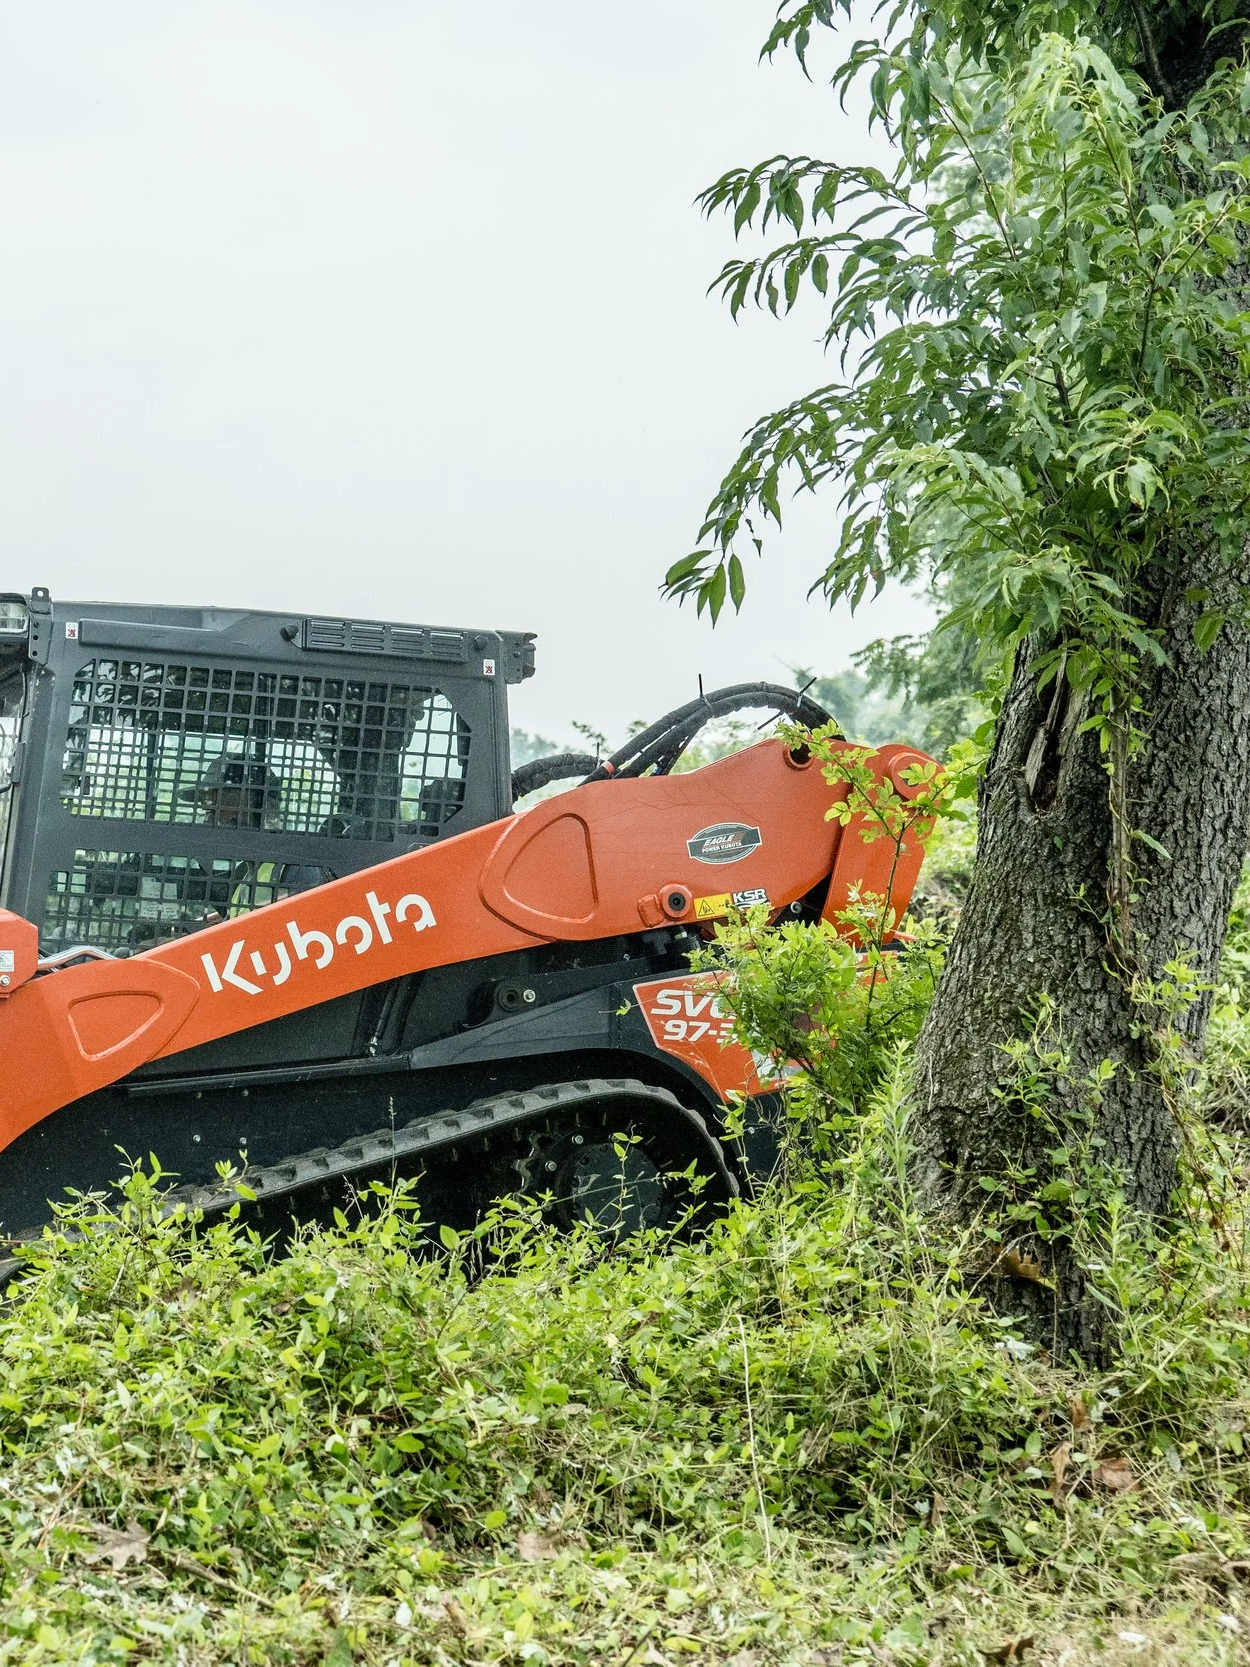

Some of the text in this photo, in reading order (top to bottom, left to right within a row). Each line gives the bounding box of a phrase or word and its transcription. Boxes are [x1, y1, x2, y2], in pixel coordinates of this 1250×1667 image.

[702, 841, 742, 853] POWER KUBOTA
[703, 834, 735, 847] EAGLE
[732, 888, 767, 903] KSR
[200, 890, 437, 996] Kubota
